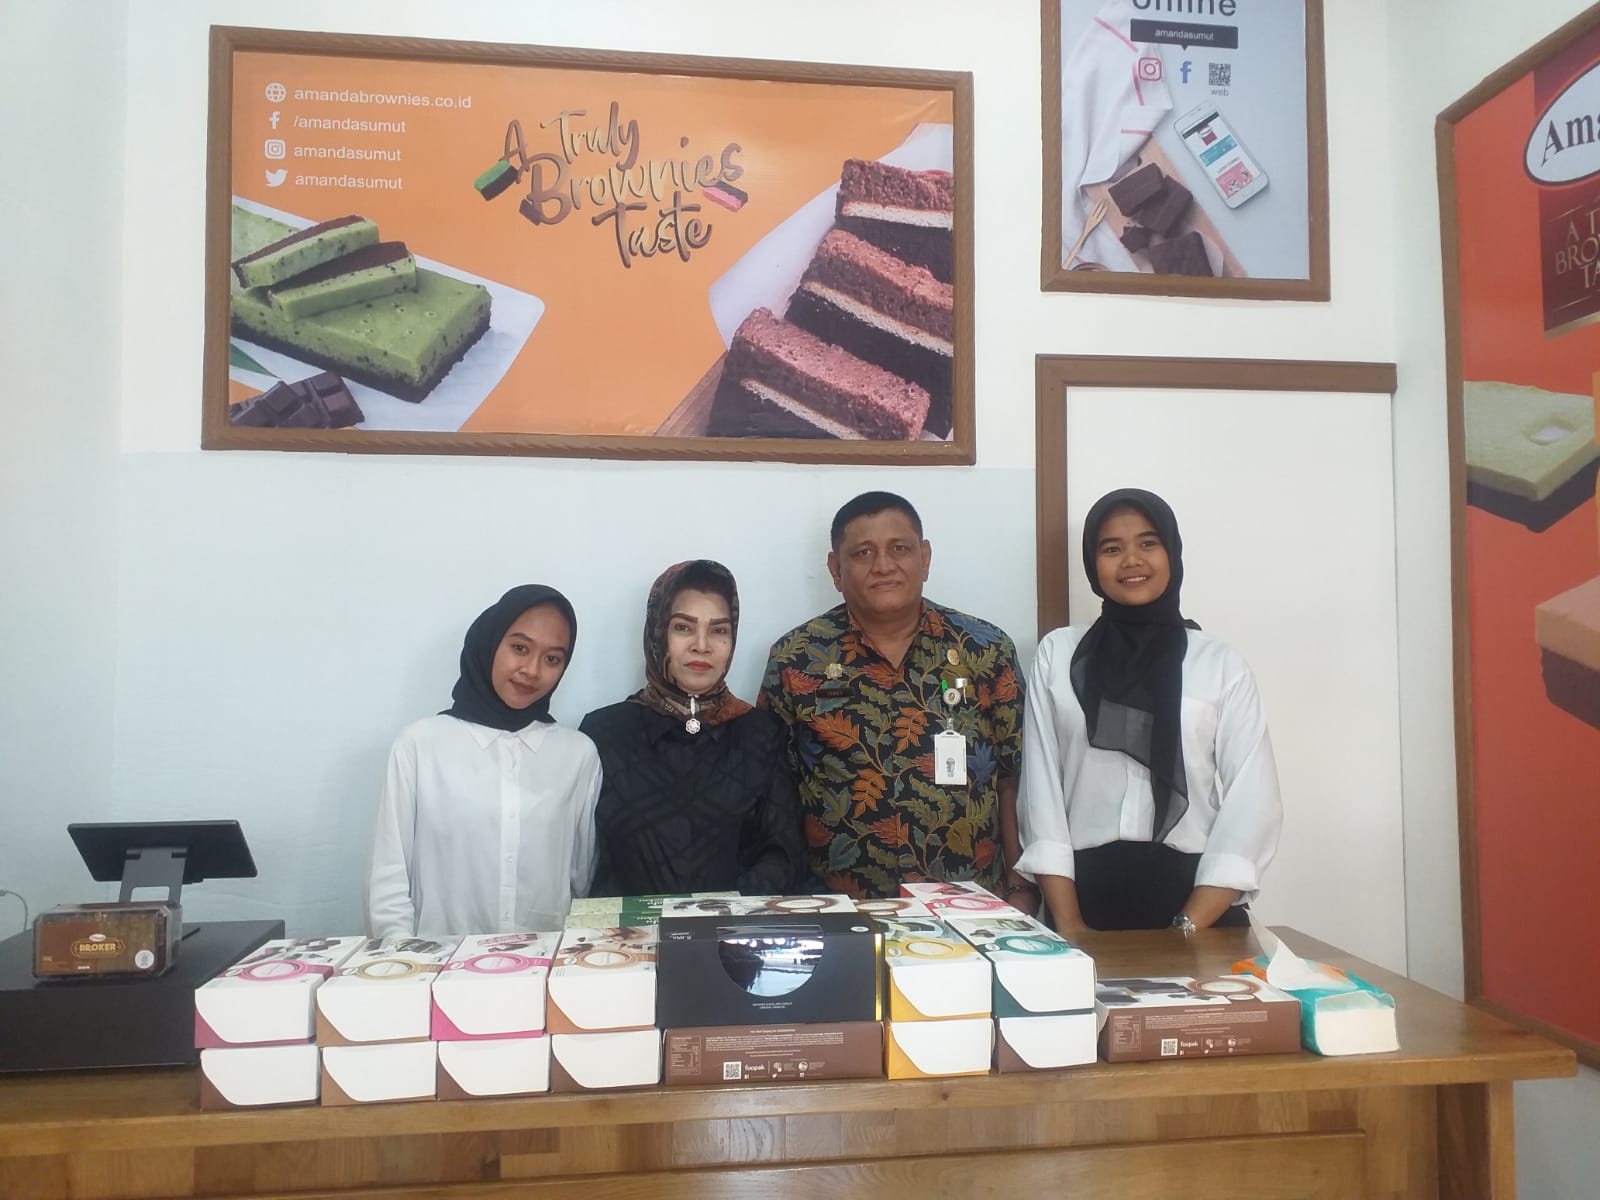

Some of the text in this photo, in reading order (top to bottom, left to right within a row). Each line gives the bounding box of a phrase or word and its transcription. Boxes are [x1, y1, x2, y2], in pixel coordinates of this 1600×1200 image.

[1154, 29, 1214, 41] amandasumut
[293, 88, 472, 109] amandabrownies.co.id
[1210, 88, 1229, 97] web
[293, 115, 406, 133] /amandasumut
[499, 100, 640, 185] A Truly
[1540, 113, 1600, 168] Am
[293, 146, 401, 161] amandasumut
[295, 175, 403, 190] amandasumut
[526, 135, 744, 226] Brownies
[591, 191, 713, 269] Taste
[1555, 234, 1600, 276] BRO
[79, 943, 116, 952] BROKER
